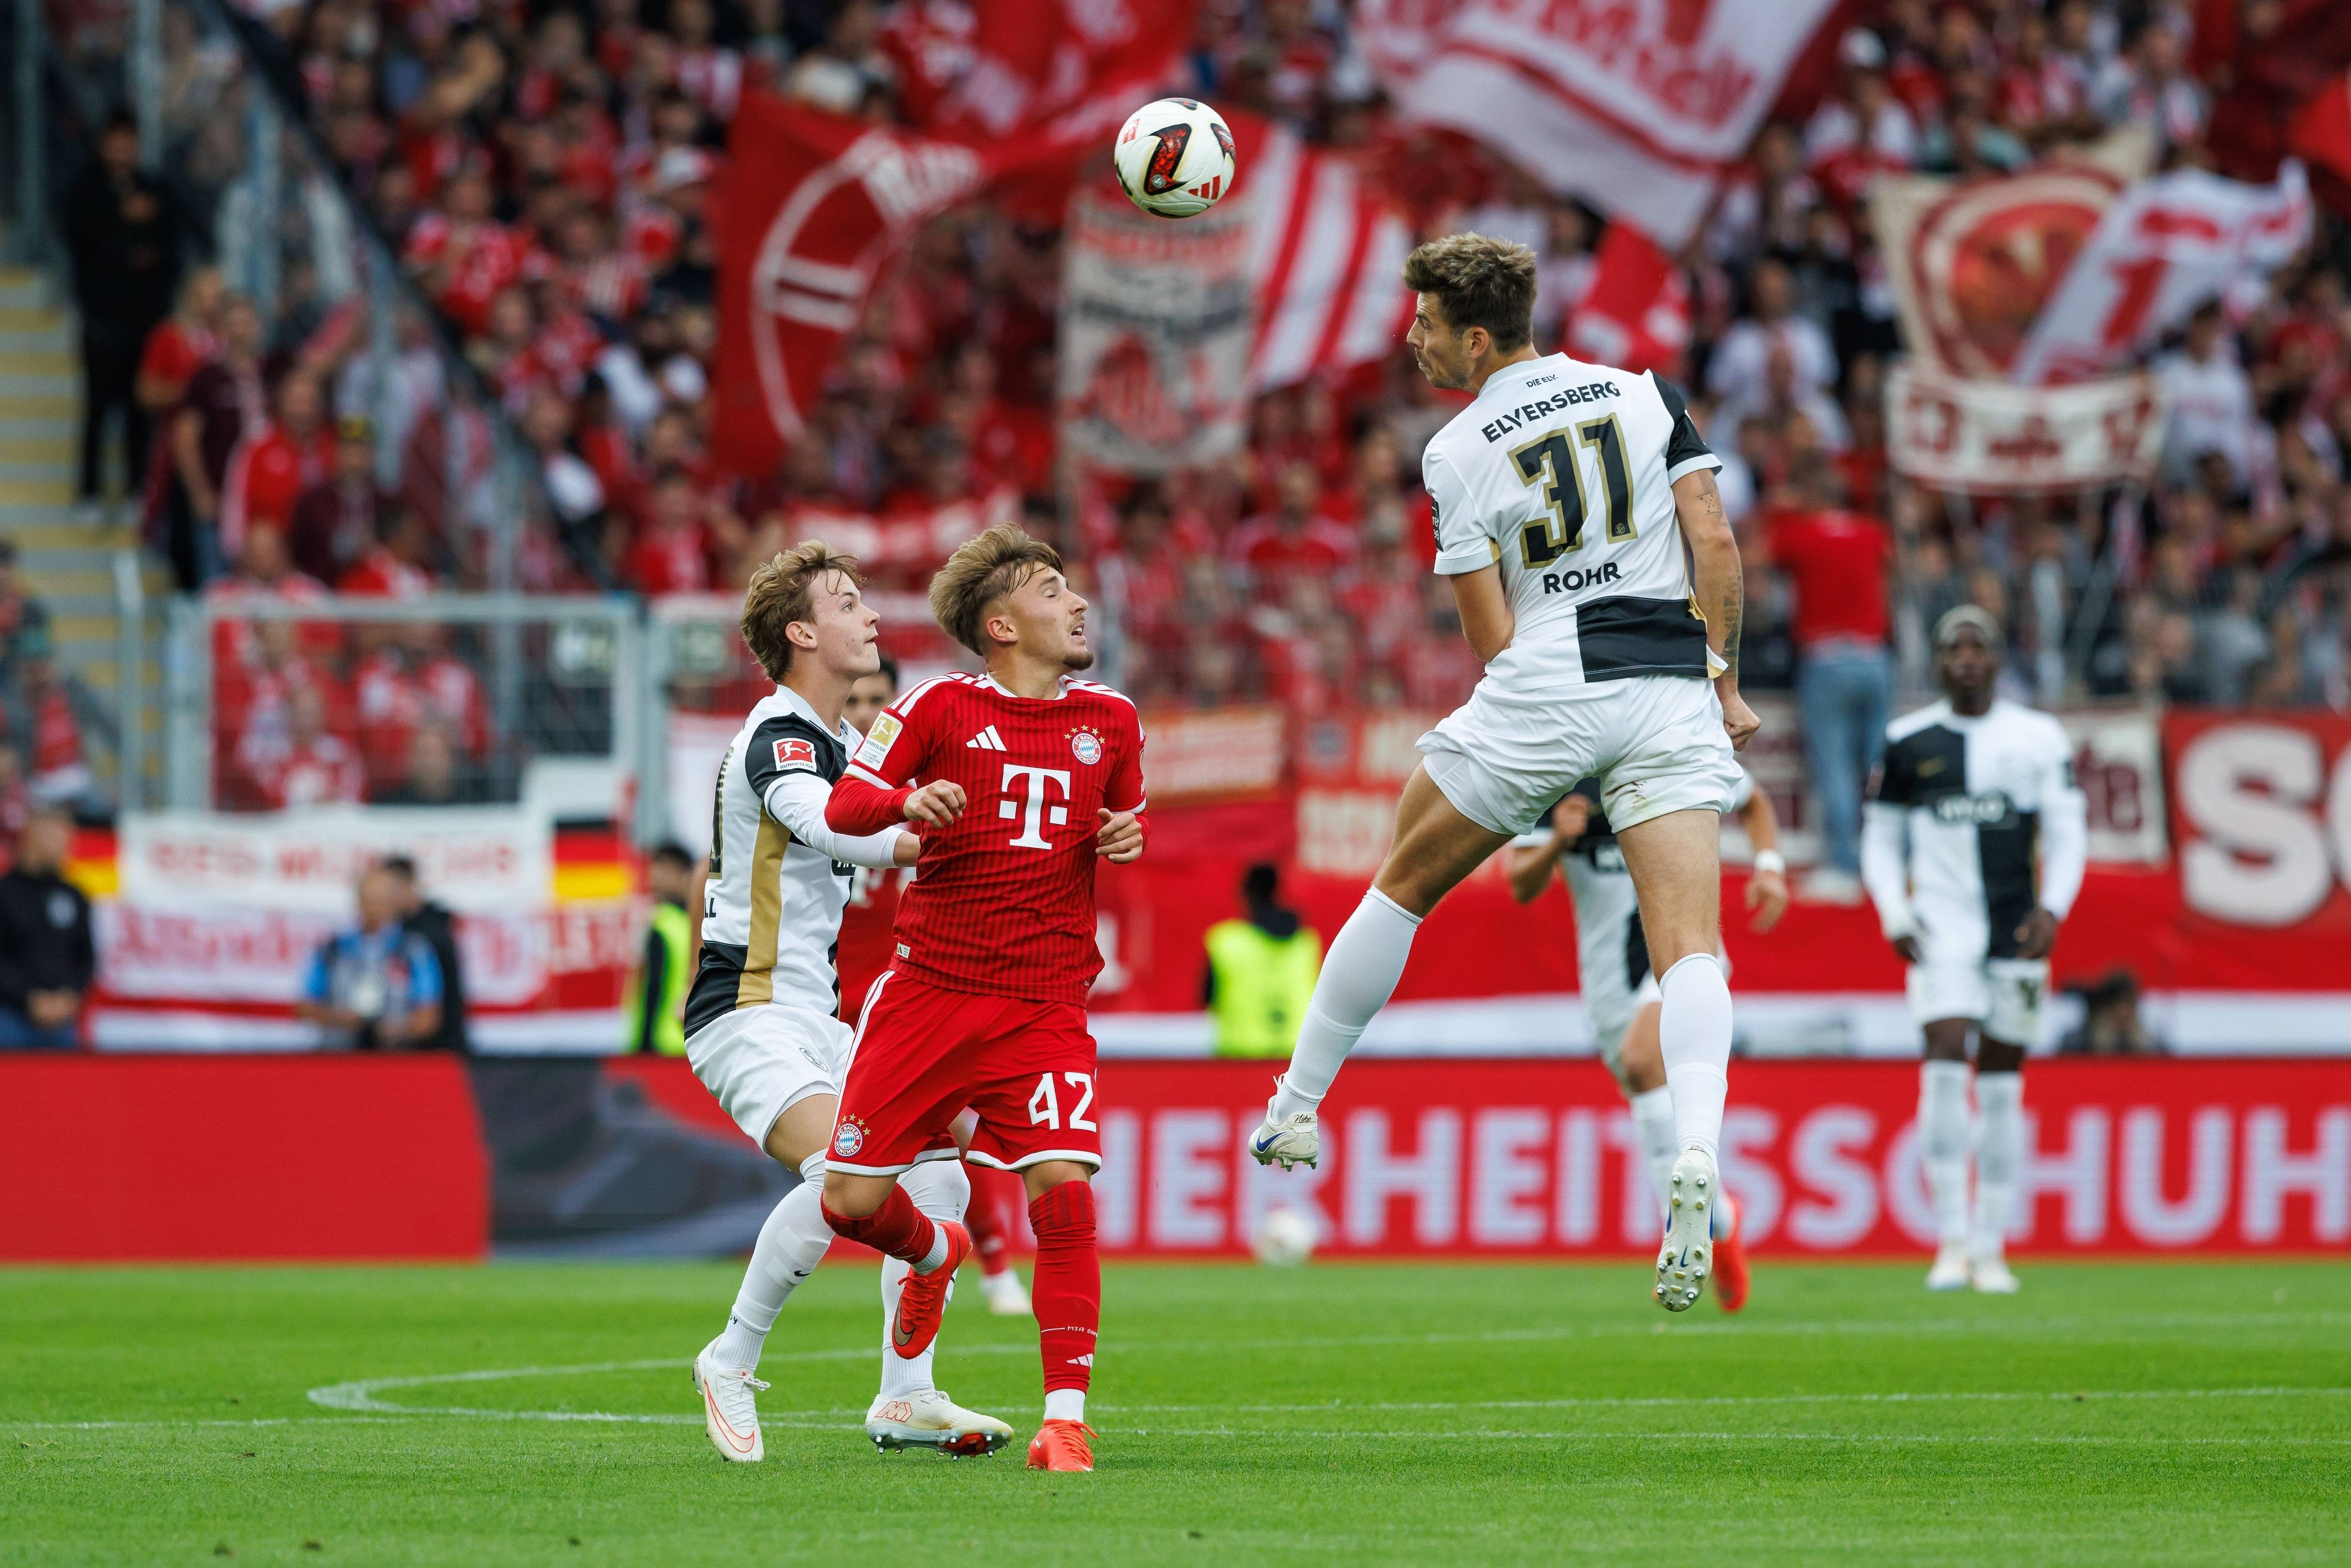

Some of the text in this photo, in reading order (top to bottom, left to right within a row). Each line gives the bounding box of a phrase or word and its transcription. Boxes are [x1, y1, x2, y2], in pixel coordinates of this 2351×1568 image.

[1526, 378, 1542, 387] DIE
[1481, 381, 1620, 443] ELVERSBERG
[1507, 412, 1638, 569] 31
[1543, 562, 1622, 594] ROHR
[1080, 735, 1099, 748] BAYERN
[1028, 1071, 1097, 1133] 42
[1294, 1114, 1311, 1123] Niko
[843, 1126, 860, 1140] BAYERN
